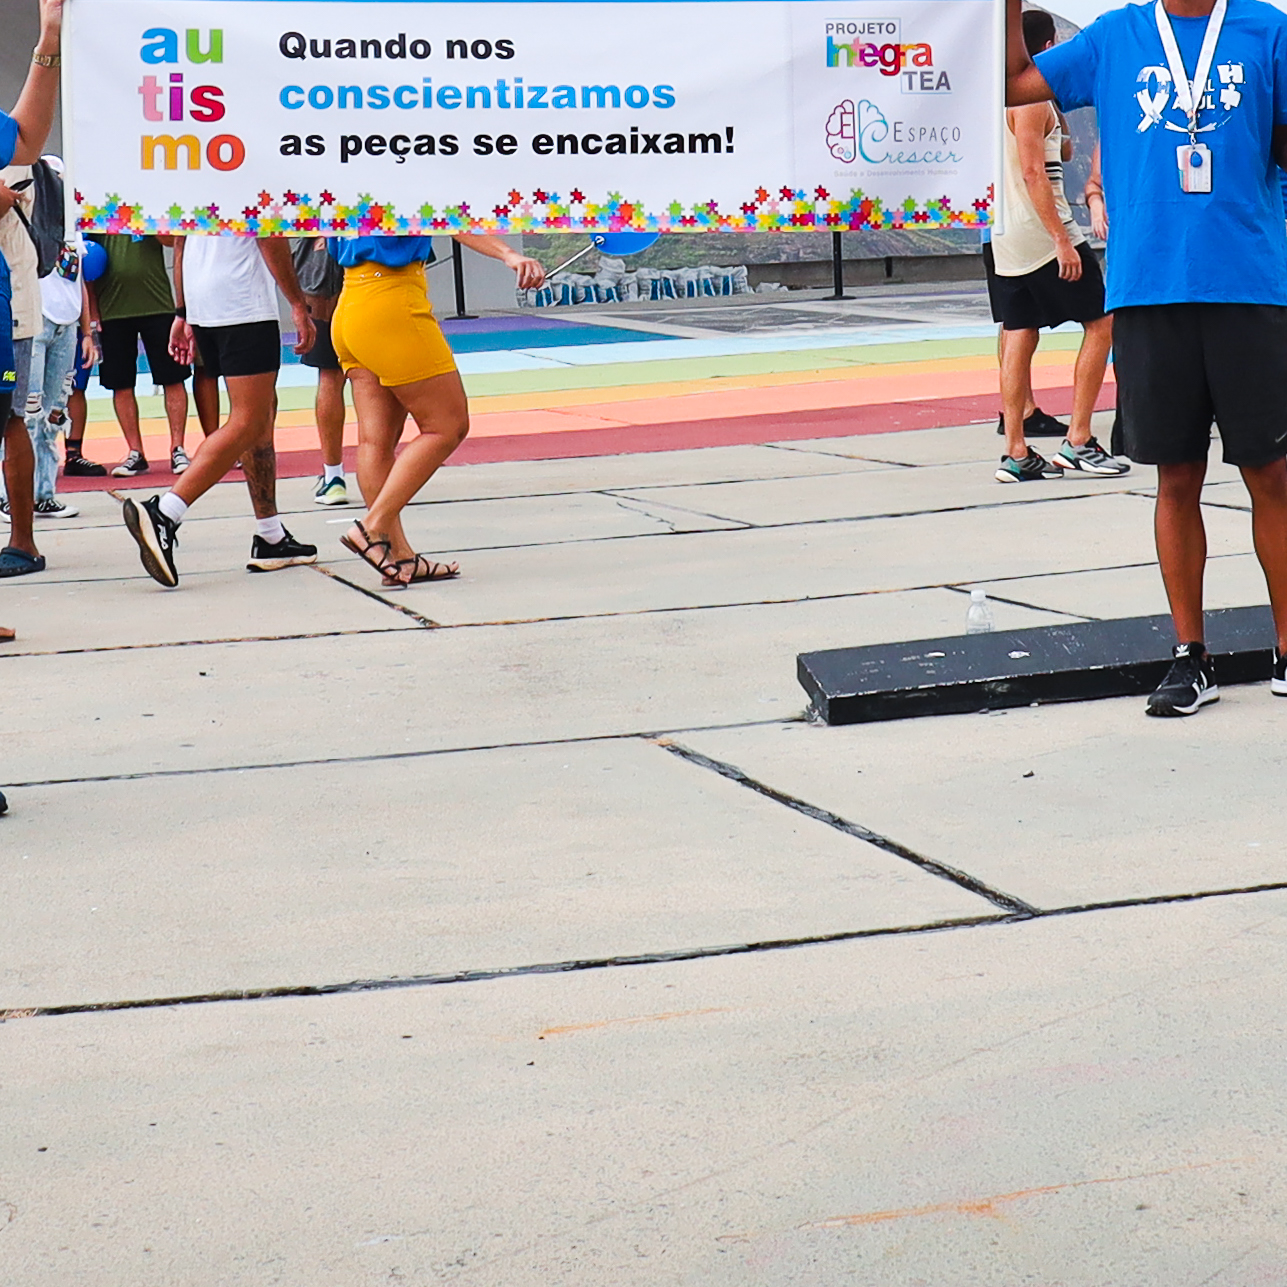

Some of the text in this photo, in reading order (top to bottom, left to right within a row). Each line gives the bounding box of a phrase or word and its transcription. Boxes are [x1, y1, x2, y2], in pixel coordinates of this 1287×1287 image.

[139, 26, 224, 65] au
[278, 31, 516, 61] Quando nos
[825, 22, 897, 35] PROJETO
[826, 35, 934, 77] Integra
[137, 72, 227, 123] tis
[278, 77, 677, 110] conscientizamos
[902, 70, 952, 91] TEA
[1171, 94, 1216, 110] AUL
[139, 133, 247, 172] mo
[279, 126, 735, 164] as peças se encaixam!
